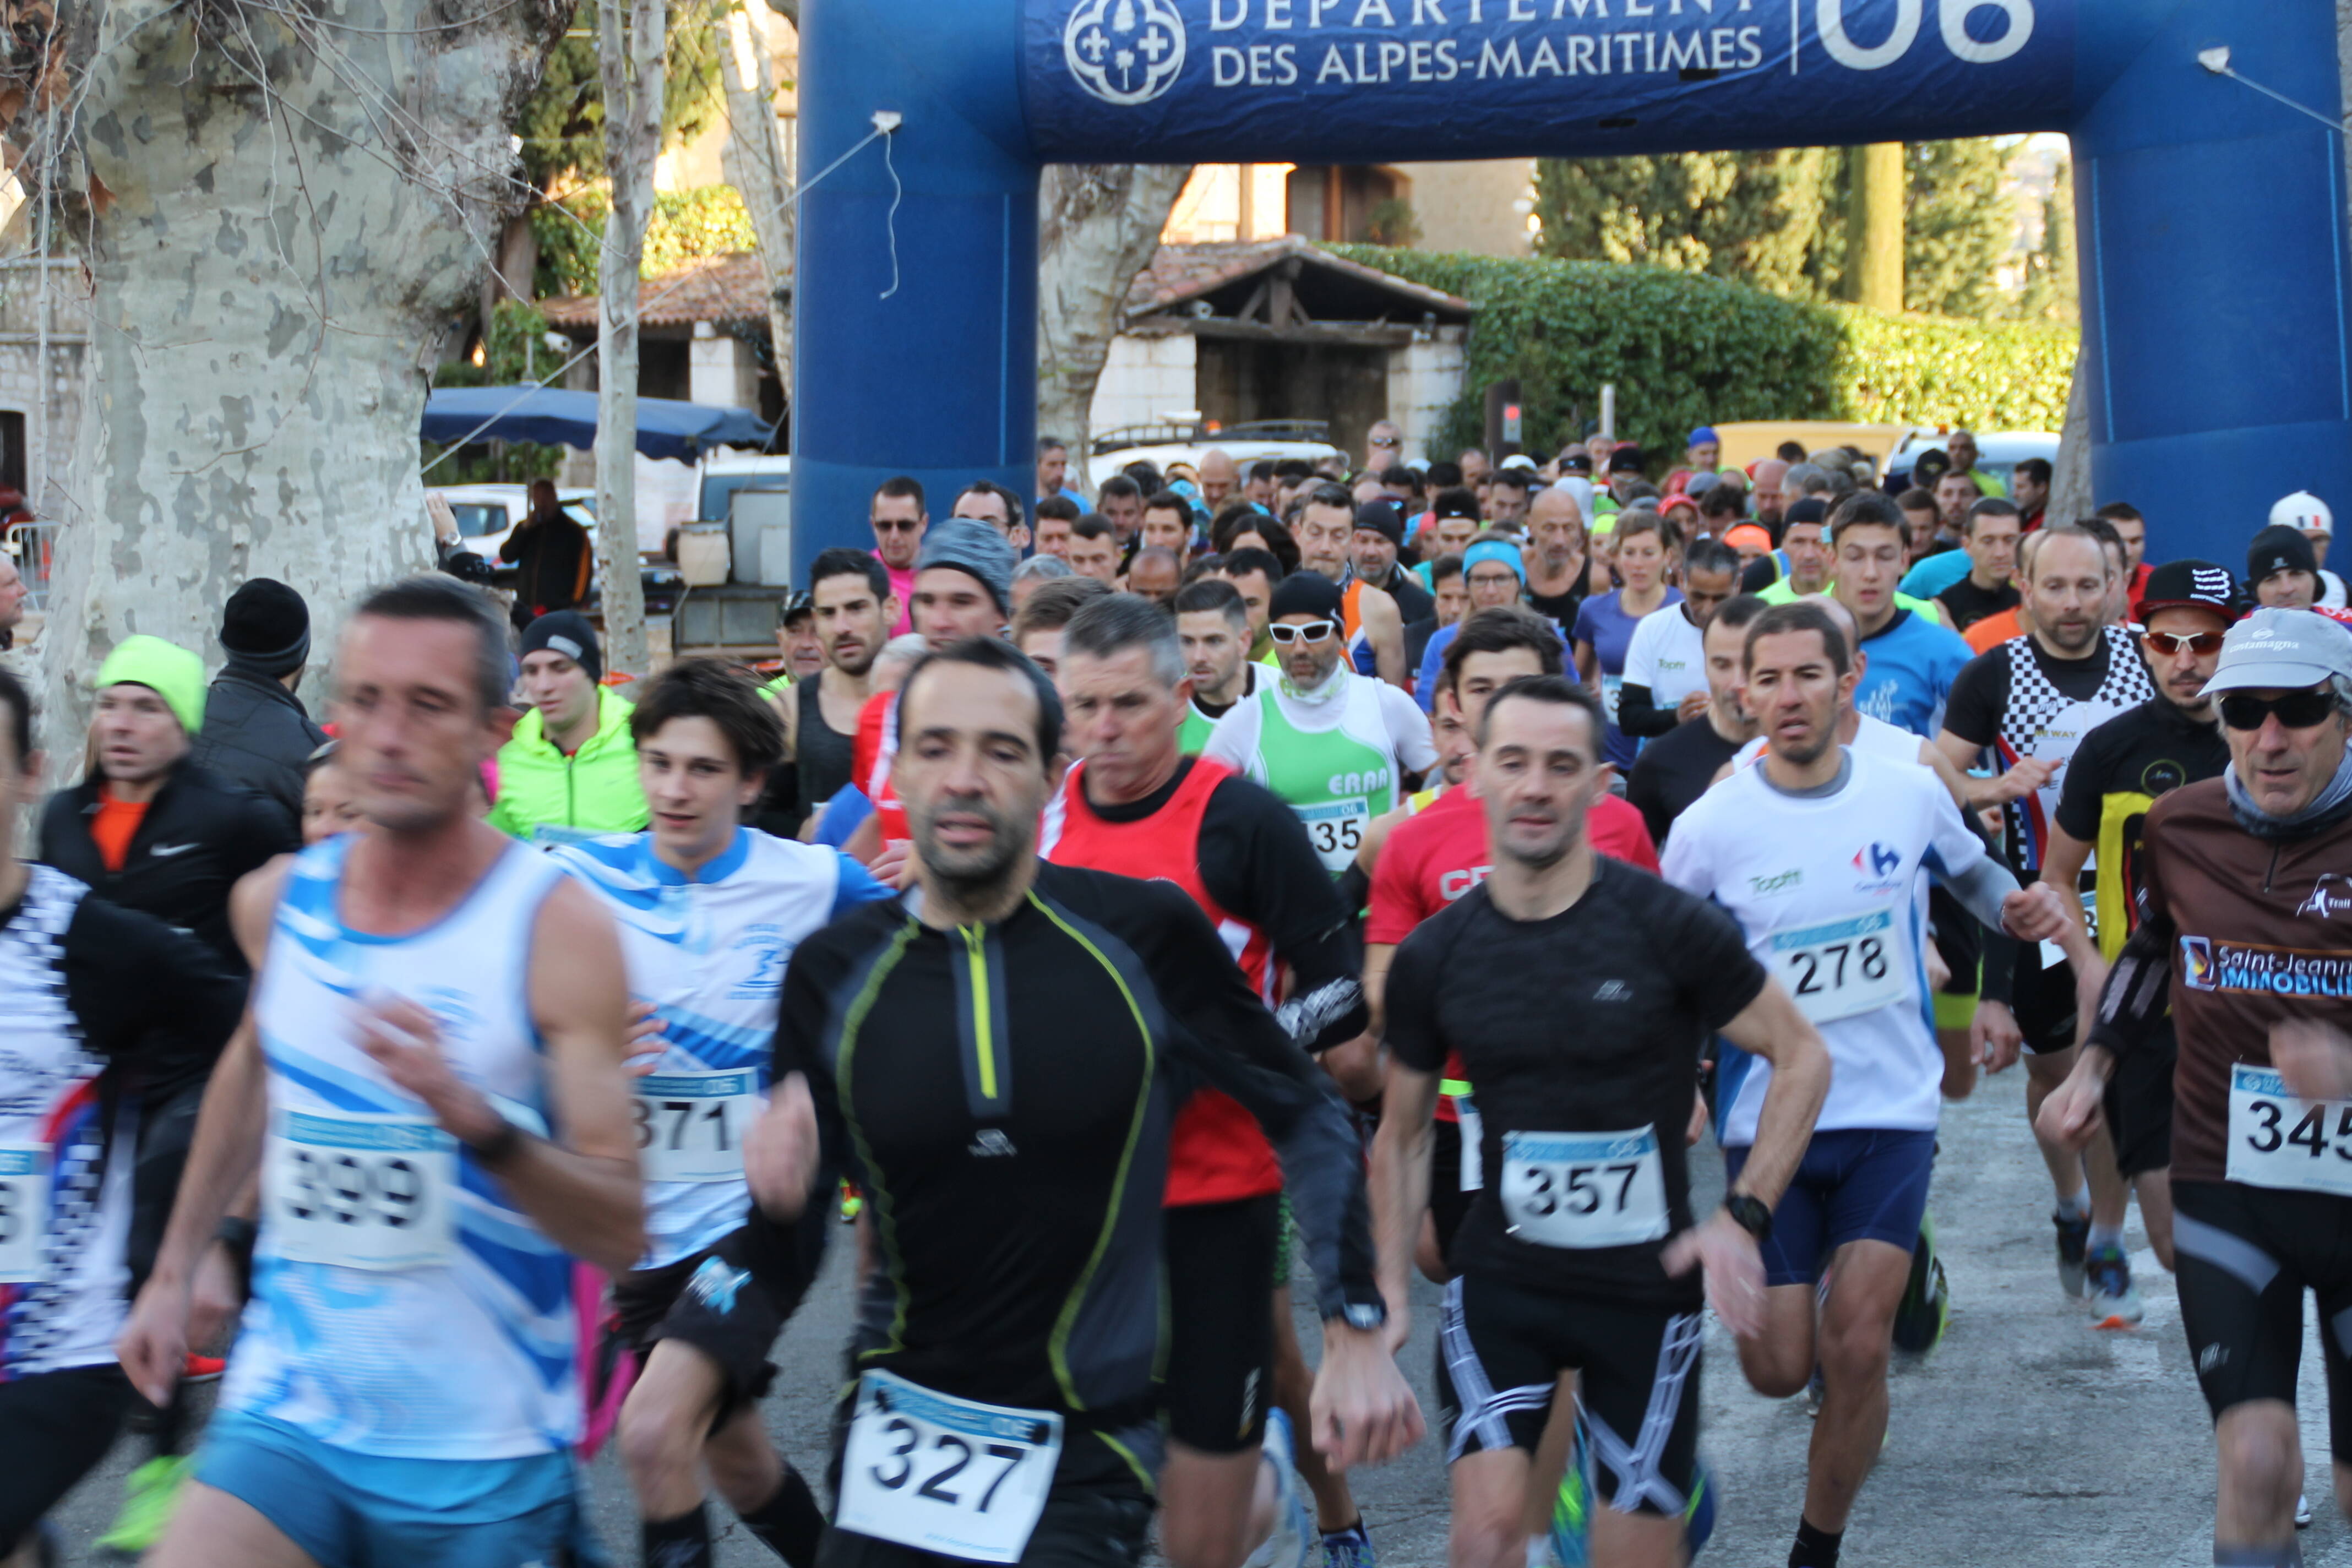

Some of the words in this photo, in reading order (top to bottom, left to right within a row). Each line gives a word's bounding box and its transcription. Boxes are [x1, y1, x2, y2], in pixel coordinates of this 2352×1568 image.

[1213, 44, 1298, 86] DES
[1315, 25, 1762, 84] ALPES-MARITIMES
[1789, 937, 1887, 998] 278
[282, 1148, 423, 1230] 399
[1523, 1162, 1640, 1217] 357
[868, 1418, 1031, 1513] 327
